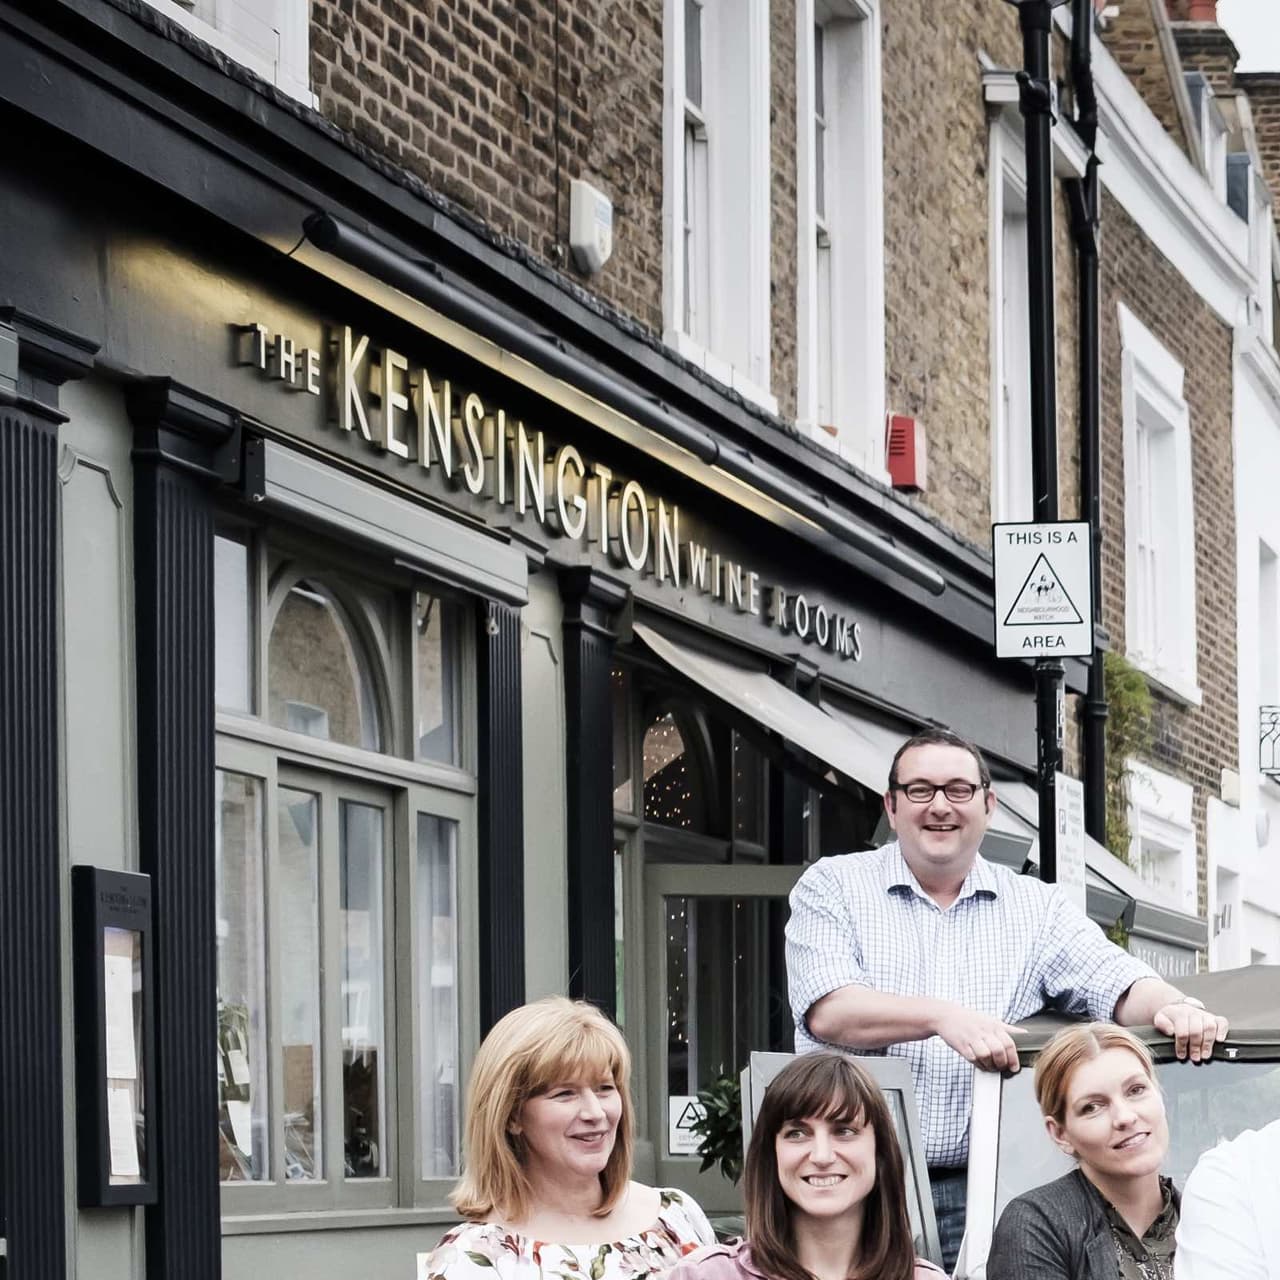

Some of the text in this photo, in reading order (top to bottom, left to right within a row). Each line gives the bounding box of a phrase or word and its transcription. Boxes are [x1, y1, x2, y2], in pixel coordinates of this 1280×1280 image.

[251, 322, 863, 664] THE KENSINGTON WINE ROOMS
[1006, 531, 1078, 545] THIS IS A
[1022, 635, 1067, 649] AREA
